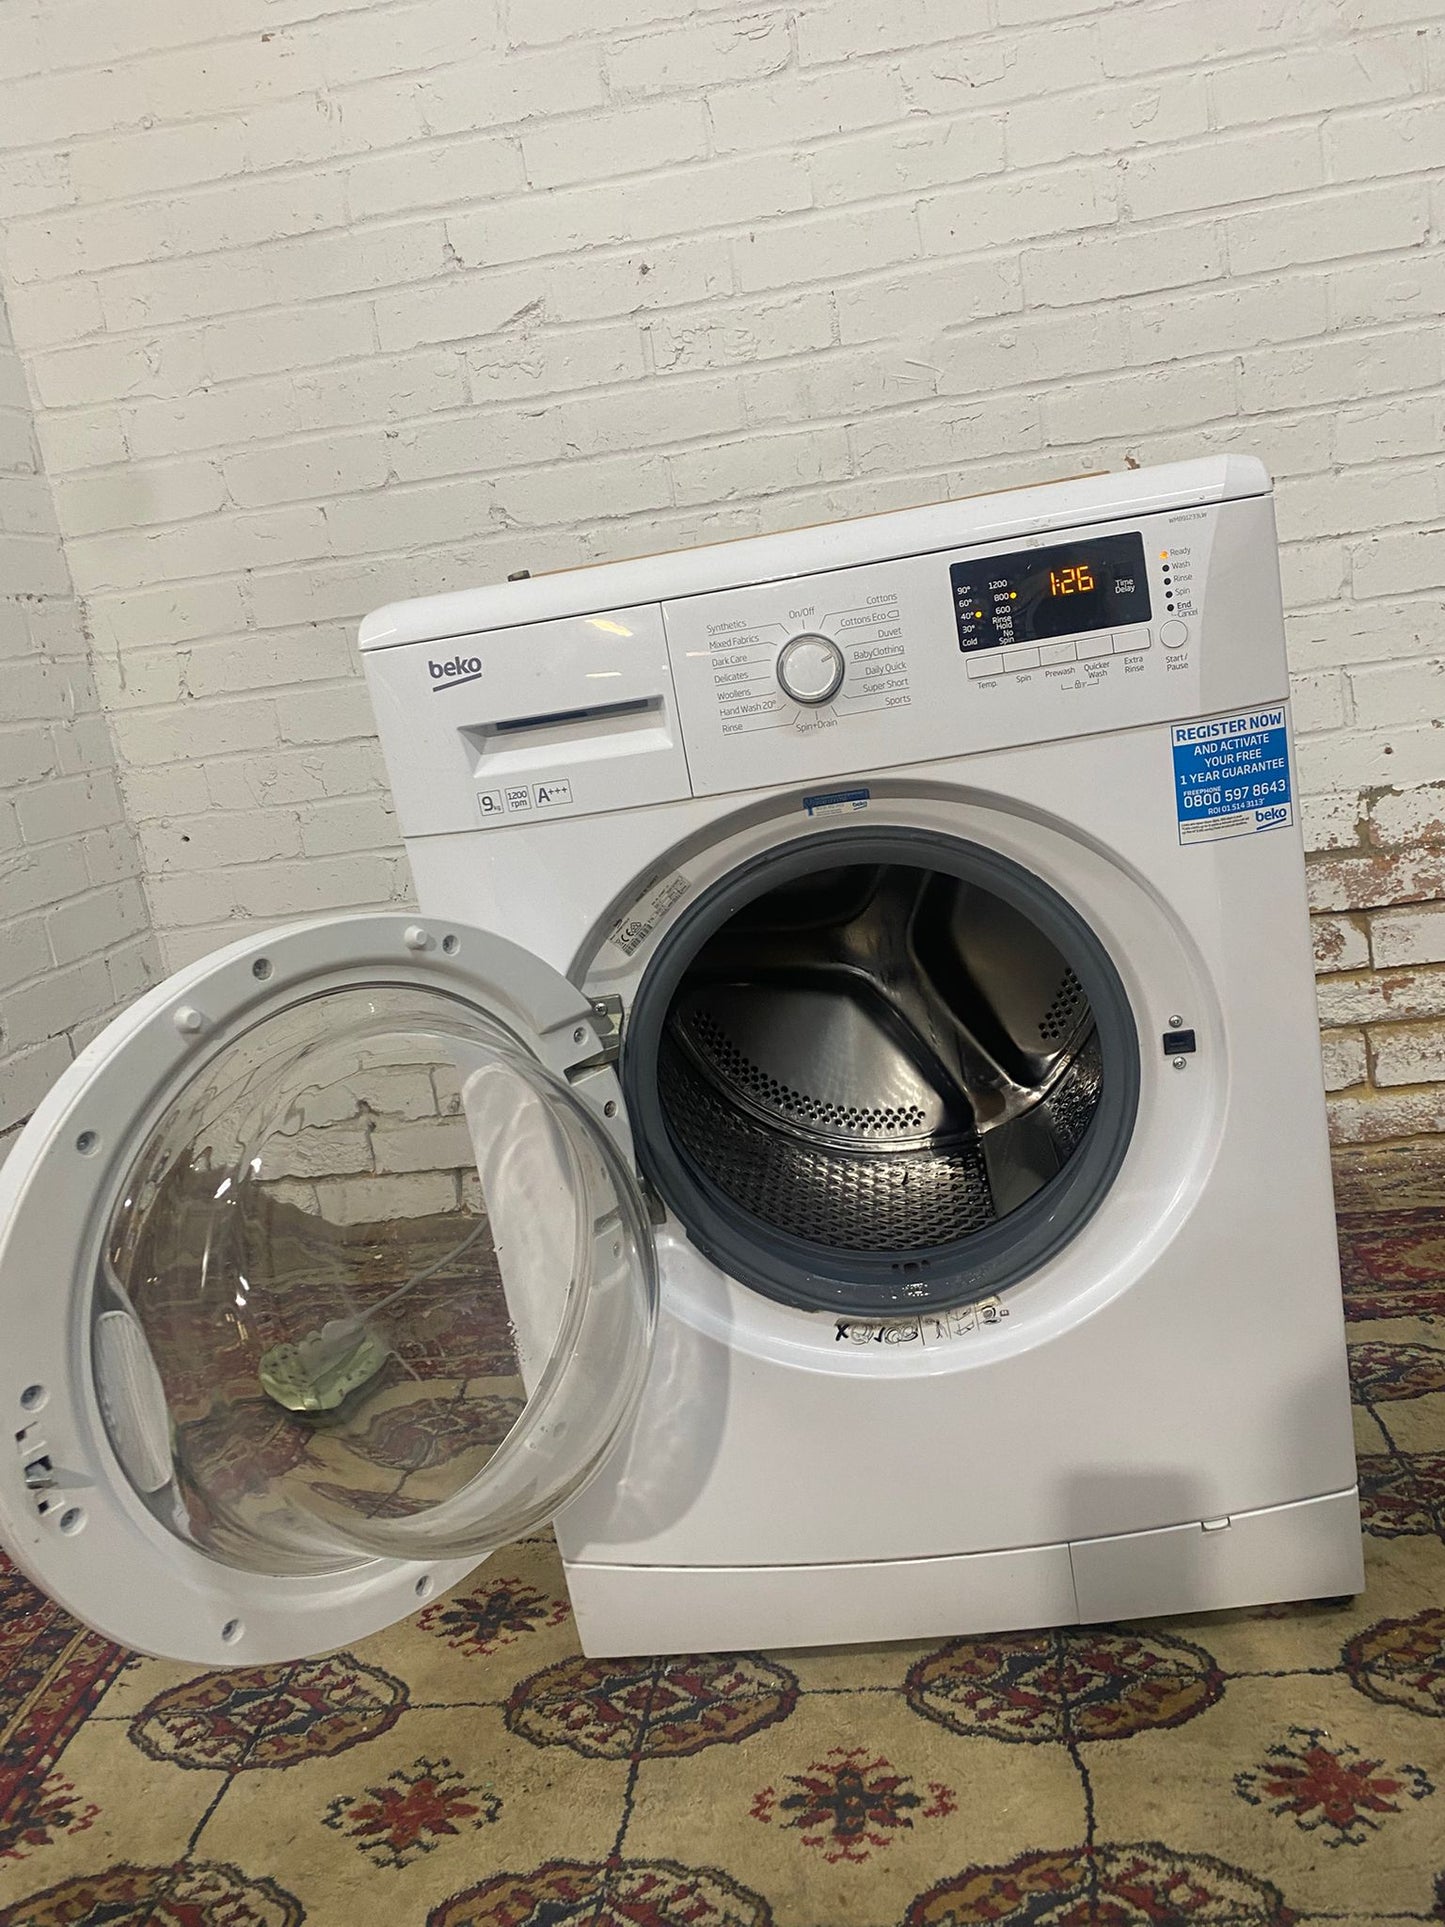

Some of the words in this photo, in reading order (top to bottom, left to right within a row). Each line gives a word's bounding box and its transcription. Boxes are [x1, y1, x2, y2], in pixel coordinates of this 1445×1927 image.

[1170, 547, 1190, 556] Ready
[1172, 560, 1190, 569] Wash
[1050, 565, 1094, 596] 1:26
[1115, 578, 1134, 587] Time
[1174, 574, 1192, 582] Rinse
[988, 580, 1008, 590] 1200
[1115, 584, 1136, 594] Delay
[994, 592, 1009, 602] 800
[1175, 587, 1190, 596] Spin
[866, 593, 898, 605] Cottons
[996, 606, 1010, 614] 600
[1177, 601, 1192, 610] End
[789, 606, 814, 620] On/Off
[1178, 608, 1198, 618] Cancel
[840, 615, 871, 628] Cottons
[872, 612, 886, 622] Eco
[992, 616, 1012, 624] Rinse
[996, 621, 1012, 630] Hold
[707, 620, 746, 634] Synthetics
[878, 628, 902, 638] Duvet
[709, 639, 732, 650] Mixed
[732, 634, 760, 645] Fabrics
[962, 638, 978, 646] Cold
[999, 637, 1014, 645] Spin
[712, 657, 730, 667] Dark
[730, 654, 748, 664] Care
[1124, 656, 1143, 664] Extra
[428, 656, 482, 679] beko
[866, 666, 884, 676] Daily
[886, 662, 907, 672] Quick
[1084, 661, 1110, 672] Quicker
[1124, 665, 1144, 674] Rinse
[1166, 662, 1188, 671] Pause
[714, 671, 748, 684] Delicates
[1045, 667, 1076, 678] Prewash
[1088, 670, 1108, 679] Wash
[1016, 675, 1032, 684] Spin
[863, 683, 886, 694] Super
[887, 678, 909, 688] Short
[717, 688, 752, 700] Woollens
[885, 695, 912, 706] Sports
[720, 706, 740, 717] Hand
[741, 702, 762, 713] Wash
[722, 722, 743, 734] Rinse
[796, 720, 838, 732] Spin+Drain
[1176, 719, 1246, 742] REGISTER
[1250, 712, 1282, 730] NOW
[1194, 743, 1218, 756] AND
[1220, 733, 1270, 751] ACTIVATE
[1204, 754, 1234, 768] YOUR
[1236, 748, 1262, 762] FREE
[1180, 775, 1188, 784] 1
[1190, 771, 1220, 784] YEAR
[1222, 758, 1284, 778] GUARANTEE
[508, 790, 527, 800] 1200
[538, 786, 567, 803] A+++
[1183, 786, 1222, 796] FREEPHONE
[1184, 792, 1220, 808] 0800
[1225, 786, 1249, 802] 597
[1252, 779, 1286, 796] 8643
[512, 800, 527, 808] rpm
[1208, 807, 1220, 815] ROI
[1222, 804, 1230, 812] 01
[1232, 802, 1246, 810] 514
[1256, 808, 1286, 822] beko
